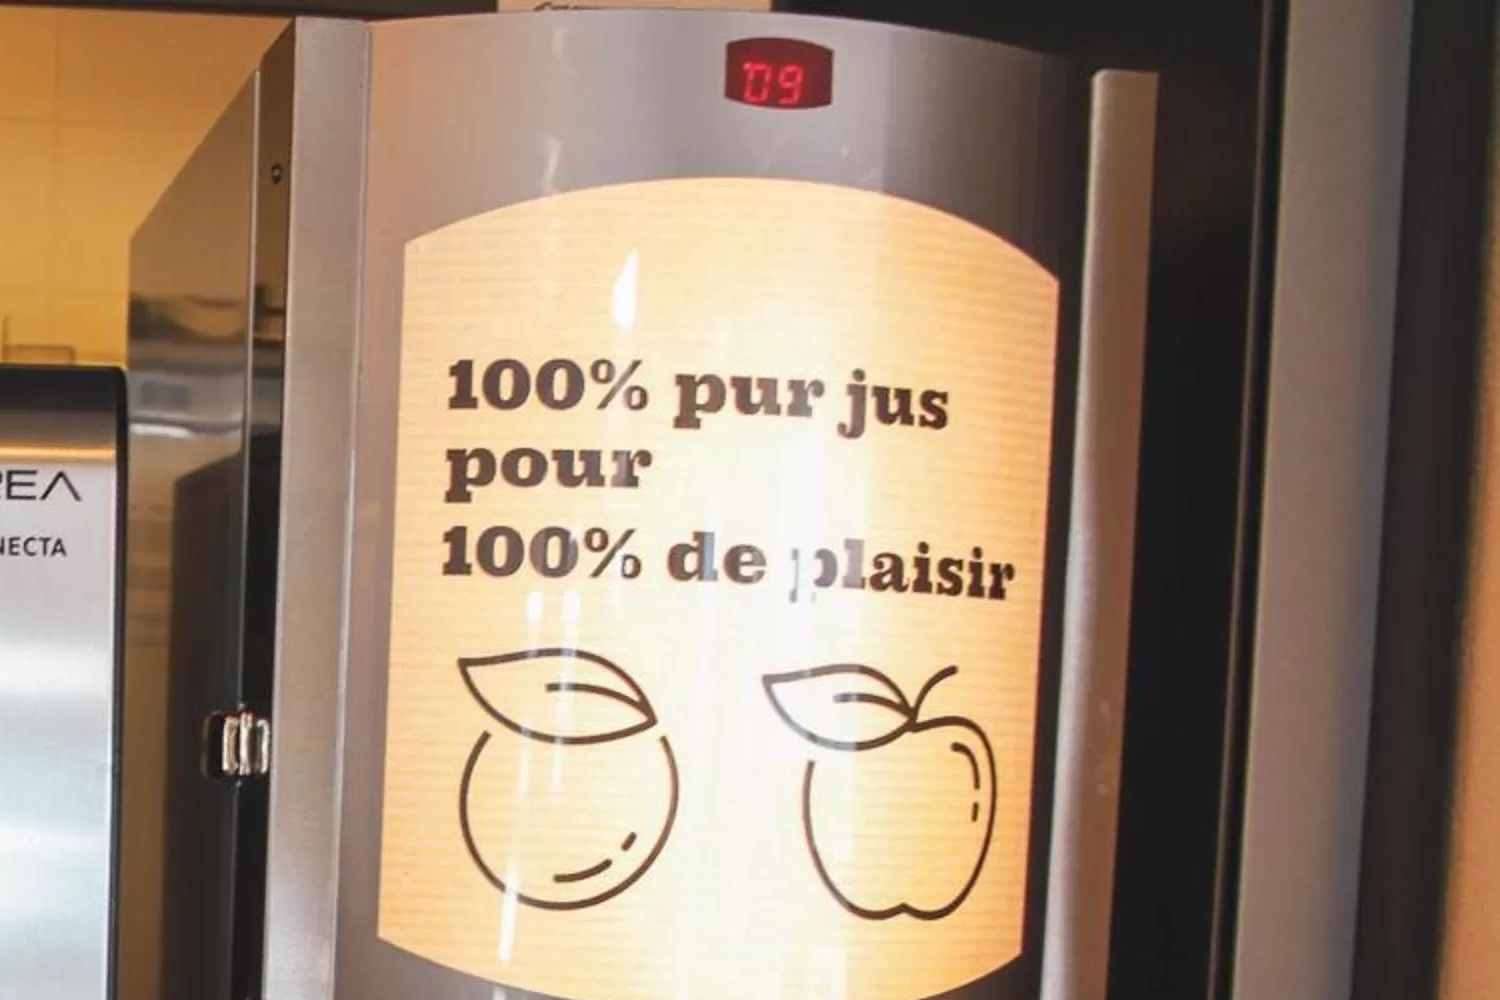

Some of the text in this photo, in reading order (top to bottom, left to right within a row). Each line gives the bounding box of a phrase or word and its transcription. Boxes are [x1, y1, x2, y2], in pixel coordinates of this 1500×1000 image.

[448, 358, 949, 439] 100% pur jus
[444, 446, 654, 503] pour
[442, 525, 1016, 604] 100% de plaisir
